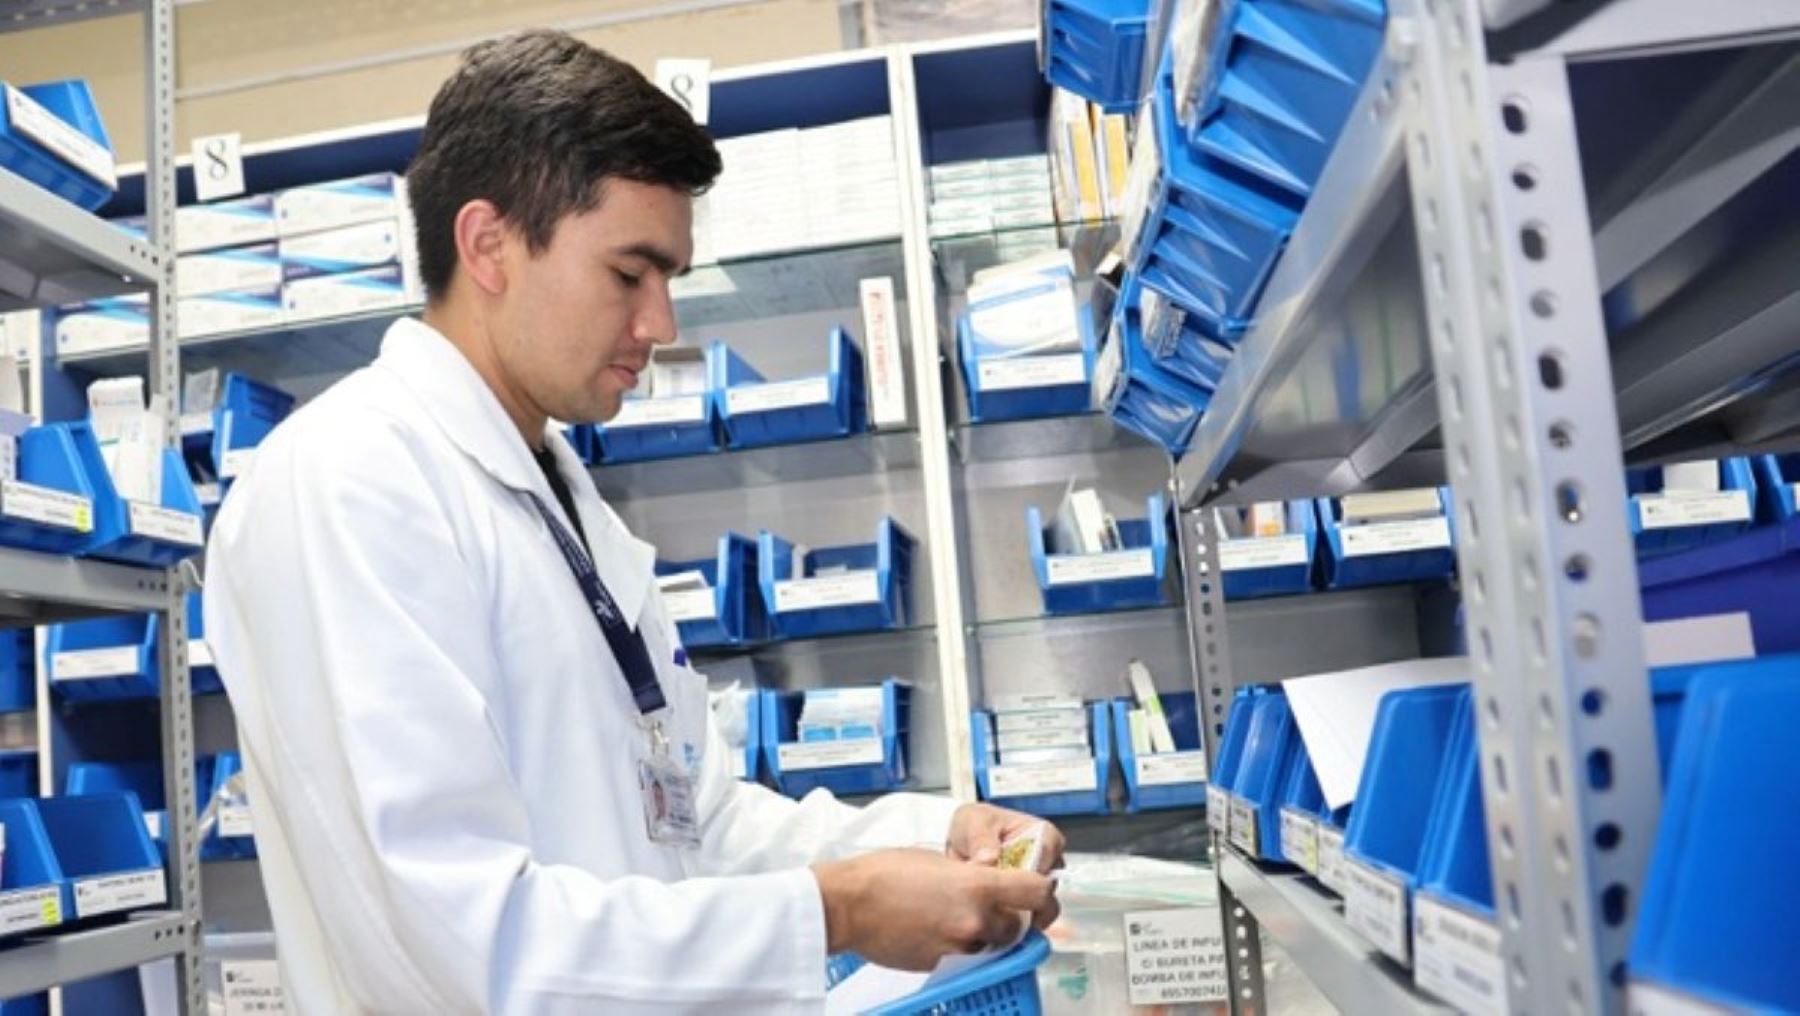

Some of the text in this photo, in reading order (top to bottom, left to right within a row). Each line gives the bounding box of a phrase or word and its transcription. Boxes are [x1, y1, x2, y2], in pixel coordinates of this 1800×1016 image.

[204, 139, 229, 181] 8
[1133, 939, 1169, 952] LINEA
[1172, 938, 1188, 949] DE
